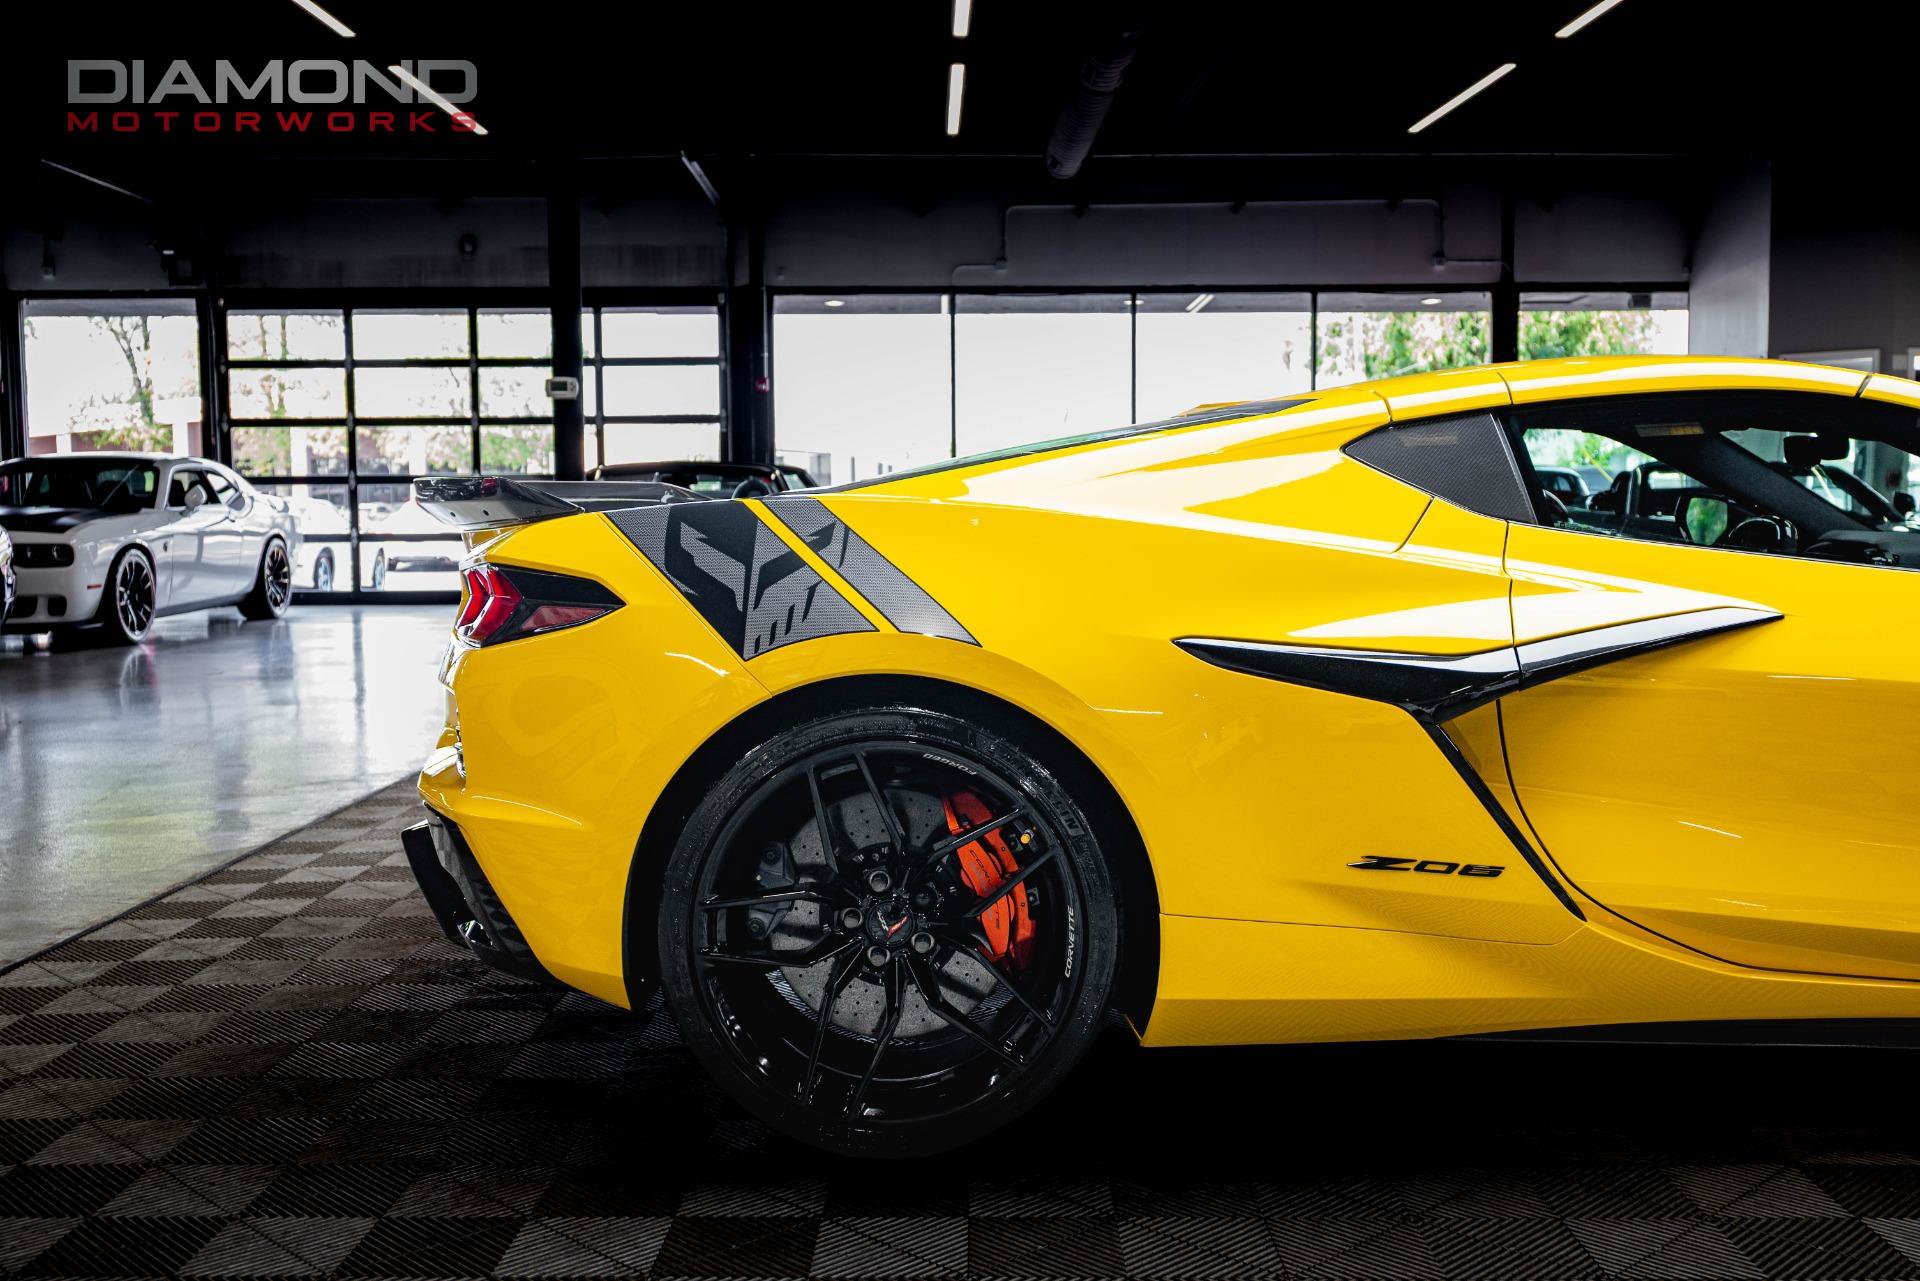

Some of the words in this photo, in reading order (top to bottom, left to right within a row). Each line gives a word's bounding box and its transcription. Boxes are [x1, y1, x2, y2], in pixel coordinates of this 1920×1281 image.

[922, 753, 977, 775] FORGED
[1347, 855, 1505, 878] Z06
[1064, 905, 1076, 978] CORVETTE
